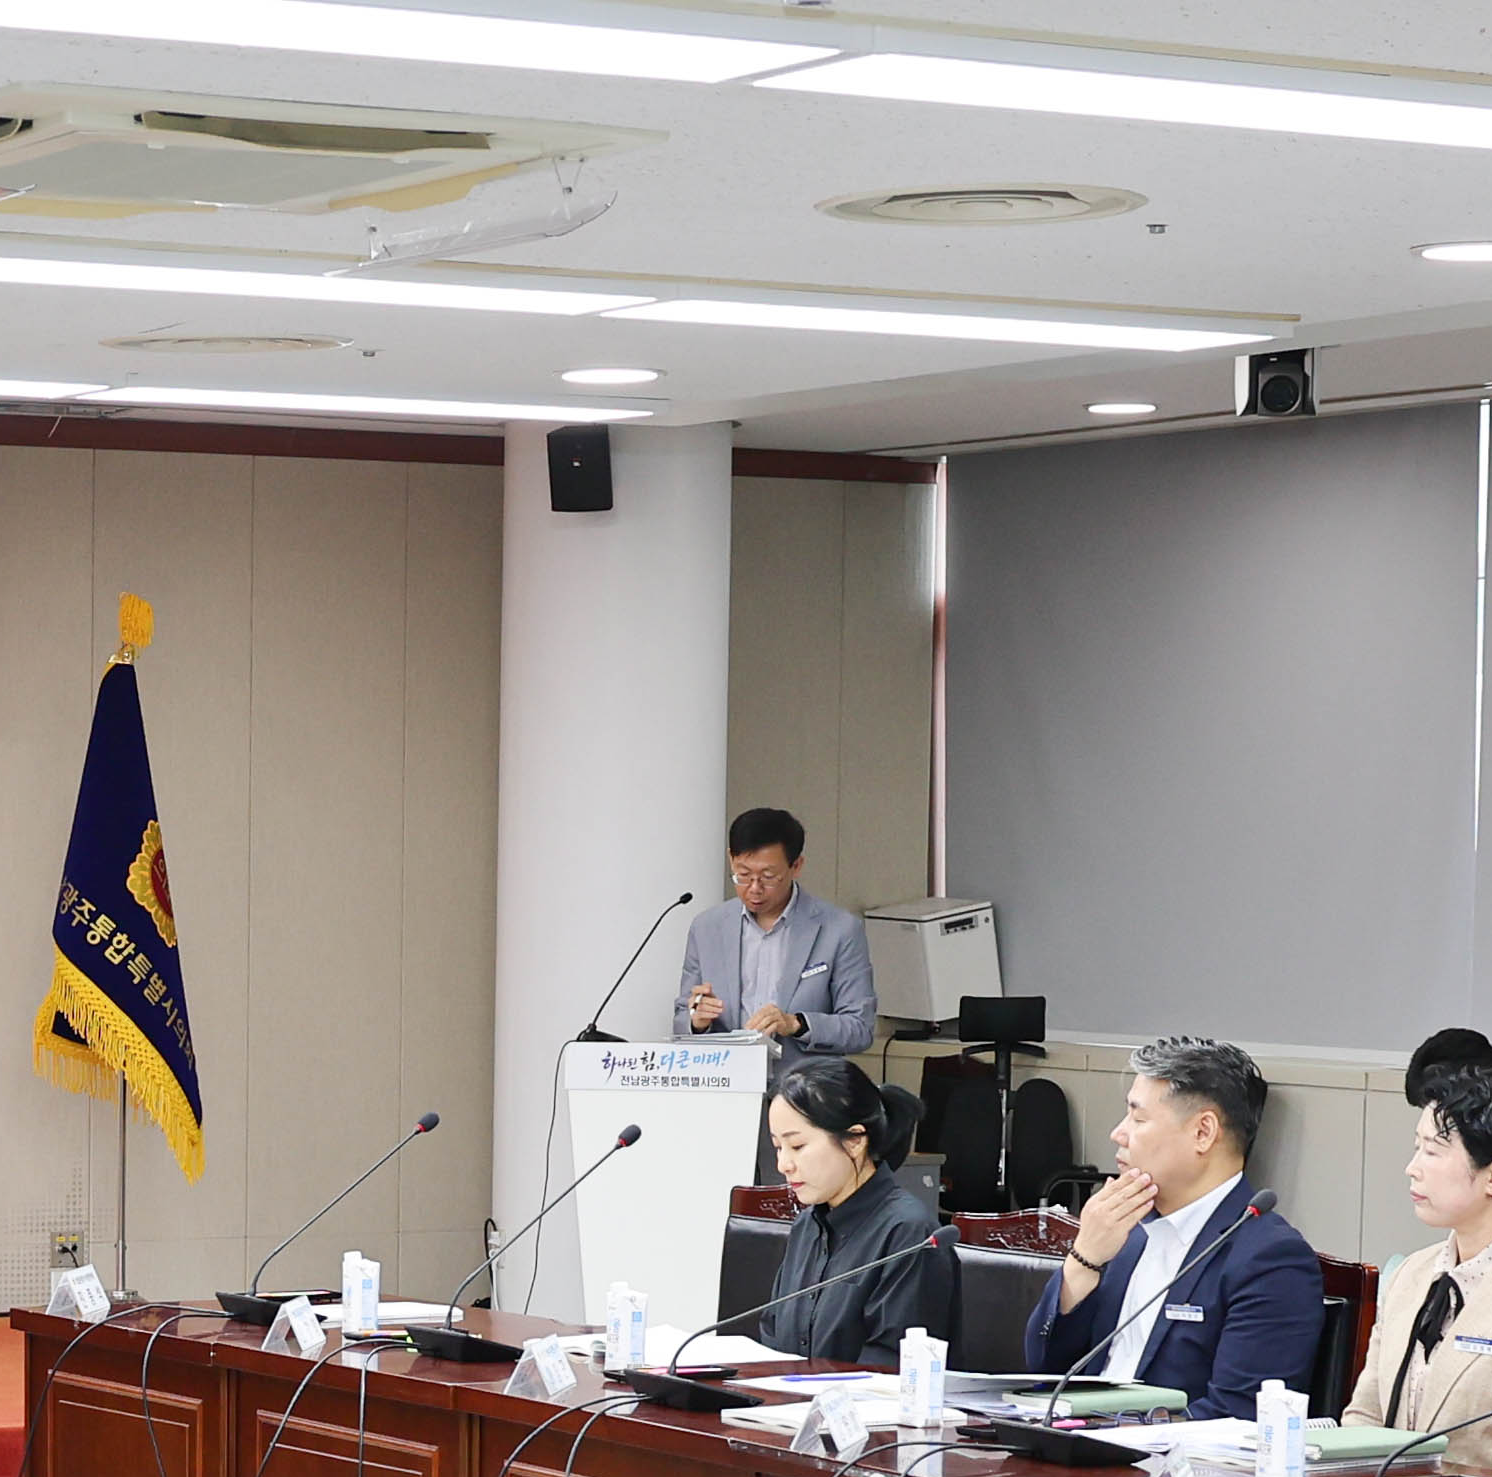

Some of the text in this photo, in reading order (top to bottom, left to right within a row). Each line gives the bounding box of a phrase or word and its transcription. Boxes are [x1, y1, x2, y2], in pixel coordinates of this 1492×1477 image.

[601, 1051, 637, 1084] 하나된
[677, 1050, 690, 1069] 큰
[693, 1050, 730, 1066] 미래!
[620, 1075, 731, 1088] 전남광주통합특별시의회
